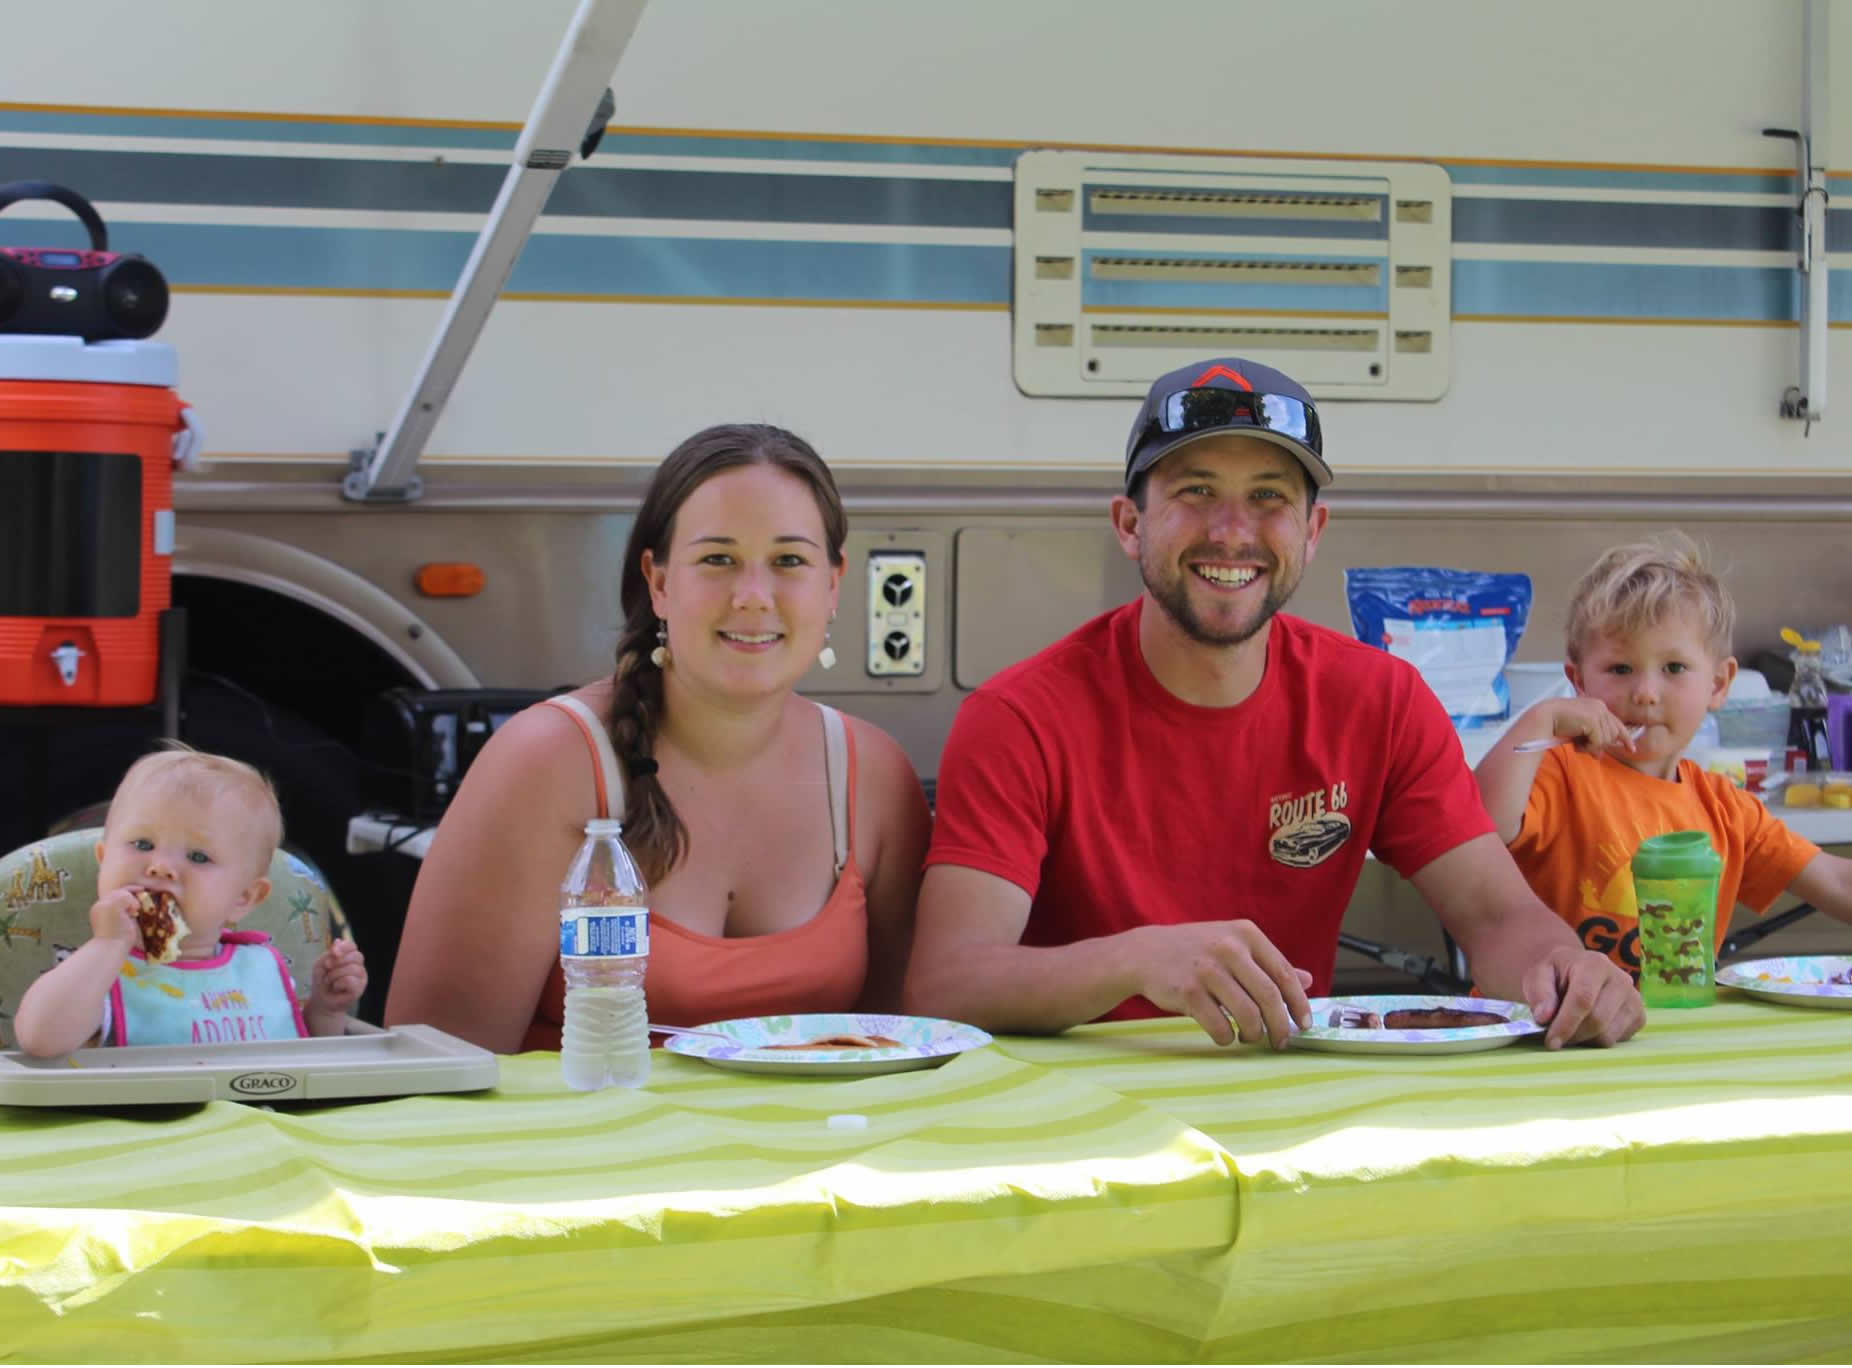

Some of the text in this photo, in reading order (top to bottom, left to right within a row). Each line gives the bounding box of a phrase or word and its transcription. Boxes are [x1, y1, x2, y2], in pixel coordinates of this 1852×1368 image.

[1269, 781, 1348, 831] ROUTE 66
[240, 1077, 290, 1089] GRACO
